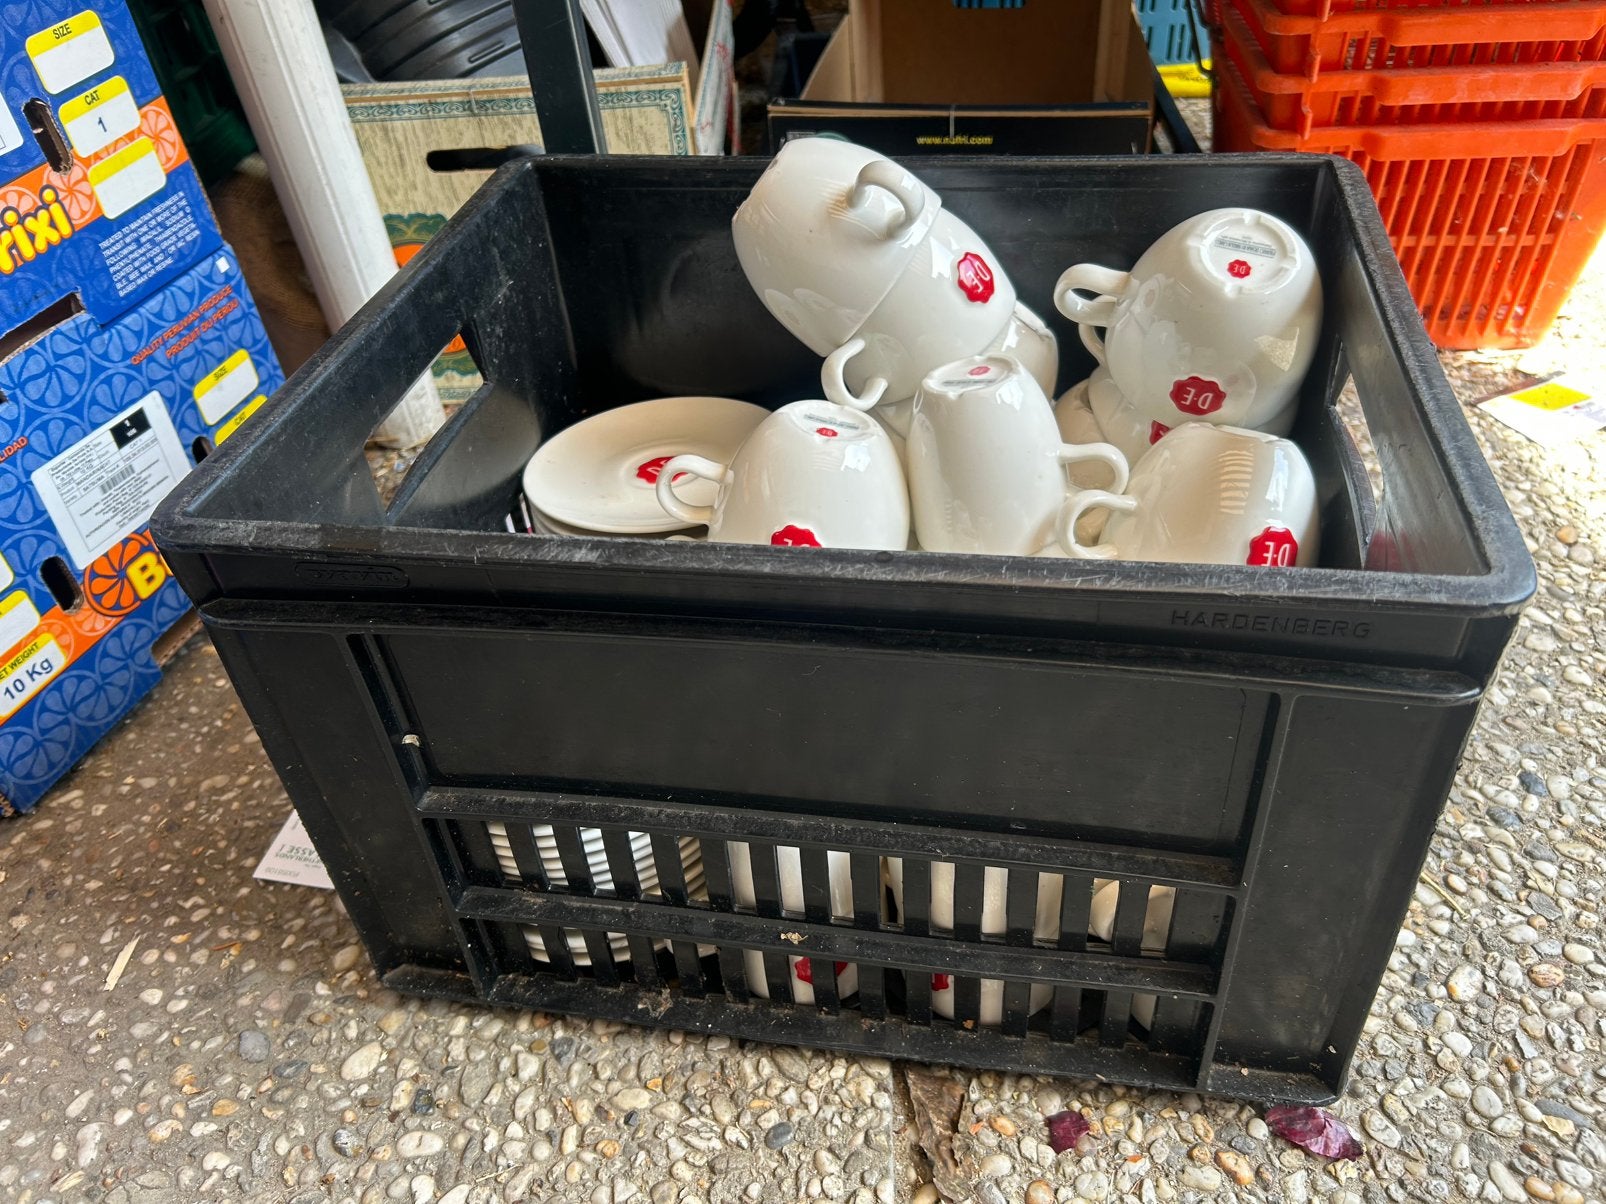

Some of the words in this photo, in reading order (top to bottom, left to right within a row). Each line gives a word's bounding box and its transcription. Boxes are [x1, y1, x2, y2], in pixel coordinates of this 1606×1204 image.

[53, 23, 72, 40] SIZE
[84, 90, 101, 106] CAT
[97, 117, 109, 133] 1
[98, 230, 123, 249] TREATED
[121, 226, 129, 234] TO
[128, 211, 152, 229] MAINTAIN
[150, 194, 179, 215] FRESHNESS
[102, 239, 124, 257] TRANSIT
[124, 231, 138, 243] WITH
[136, 224, 148, 235] ONE
[148, 218, 156, 227] OR
[155, 209, 170, 222] MORE
[169, 204, 178, 213] OF
[177, 198, 187, 208] THE
[112, 264, 134, 281] COATED
[132, 255, 146, 267] WITH
[145, 246, 160, 258] FOOD
[159, 234, 177, 249] GRADE
[152, 252, 164, 263] AND
[118, 281, 136, 297] BASED
[131, 337, 163, 365] QUALITY
[163, 309, 199, 341] PERUVIAN
[198, 284, 232, 314] PRODUCE
[165, 327, 201, 358] PRODUIT
[200, 318, 213, 331] DU
[1170, 608, 1372, 639] HARDENBERG
[9, 642, 40, 672] WEIGHT
[3, 677, 26, 700] 10
[26, 658, 54, 682] Kg
